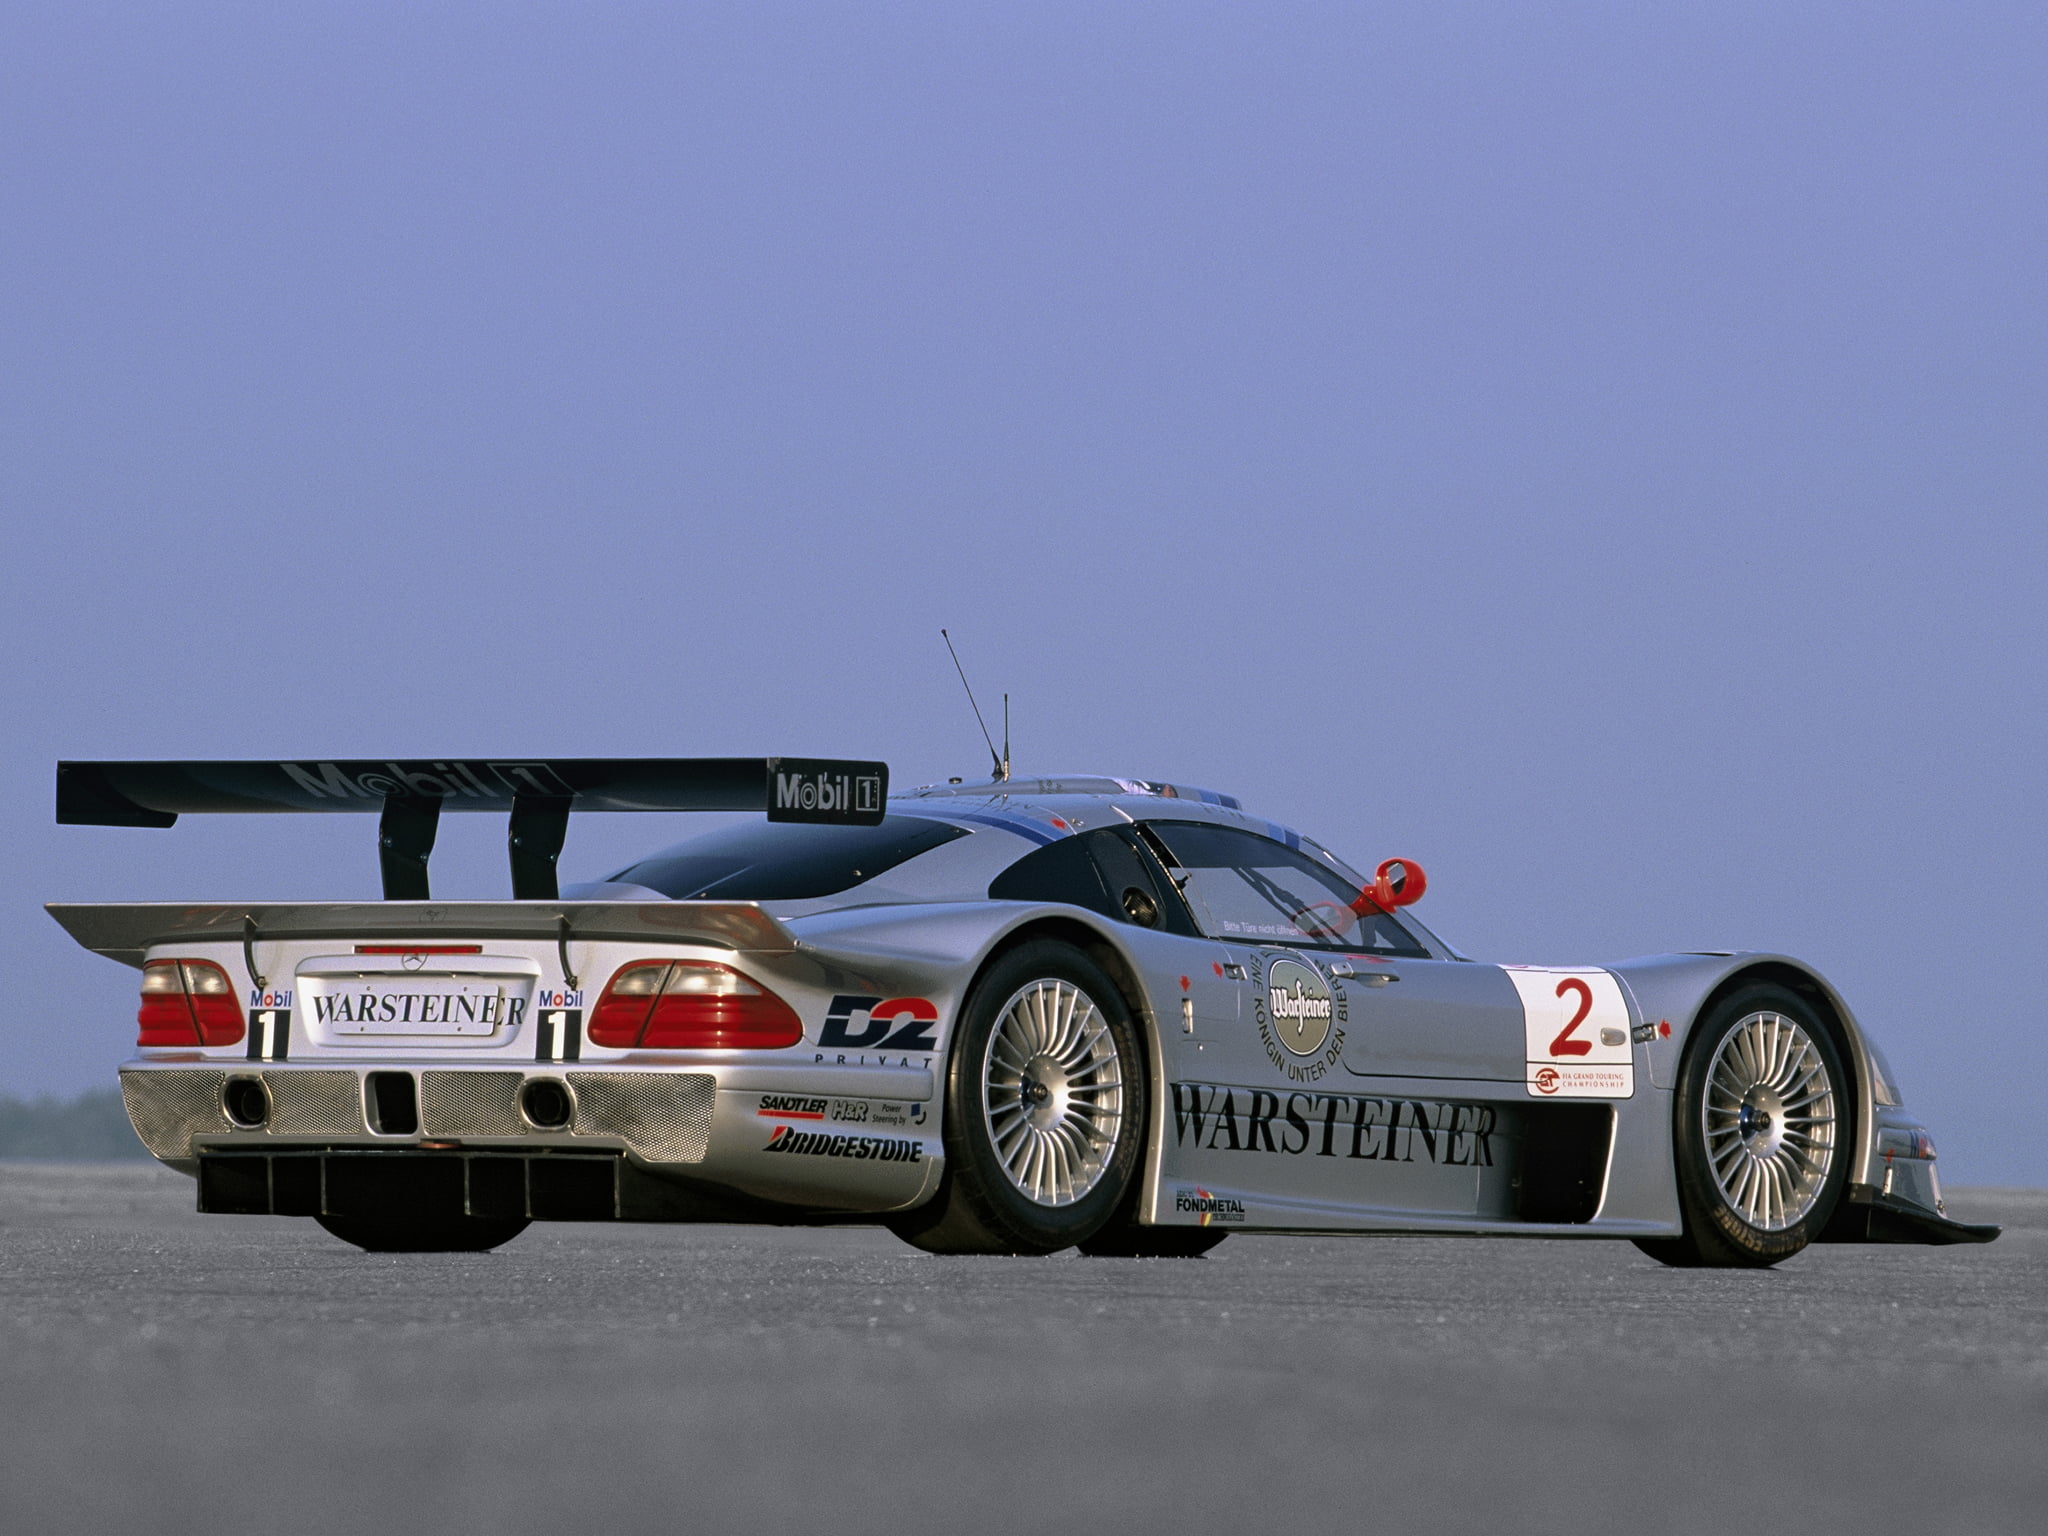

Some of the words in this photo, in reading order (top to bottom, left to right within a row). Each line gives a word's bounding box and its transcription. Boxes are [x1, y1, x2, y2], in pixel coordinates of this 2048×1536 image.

[280, 763, 498, 798] Mobil
[777, 773, 849, 810] Mobil
[250, 990, 292, 1007] Mobil
[312, 993, 526, 1026] WARSTEINER
[539, 990, 583, 1007] Mobil
[818, 995, 938, 1050] D2
[1250, 953, 1264, 992] EINE
[1288, 1061, 1327, 1083] UNTER
[1326, 1028, 1346, 1066] DEN
[1549, 977, 1593, 1057] 2
[258, 1011, 276, 1058] 1
[547, 1011, 567, 1059] 1
[816, 1054, 932, 1069] PRIVAT
[1562, 1080, 1624, 1089] CHAMPIONSHIP
[759, 1095, 828, 1113] SANDTLER
[832, 1100, 869, 1122] H&R
[872, 1114, 897, 1126] Steering
[882, 1103, 902, 1113] Power
[1169, 1083, 1497, 1167] WARSTEINER
[763, 1126, 923, 1163] BRIDGESTONE
[1176, 1198, 1245, 1213] FONDMETAL
